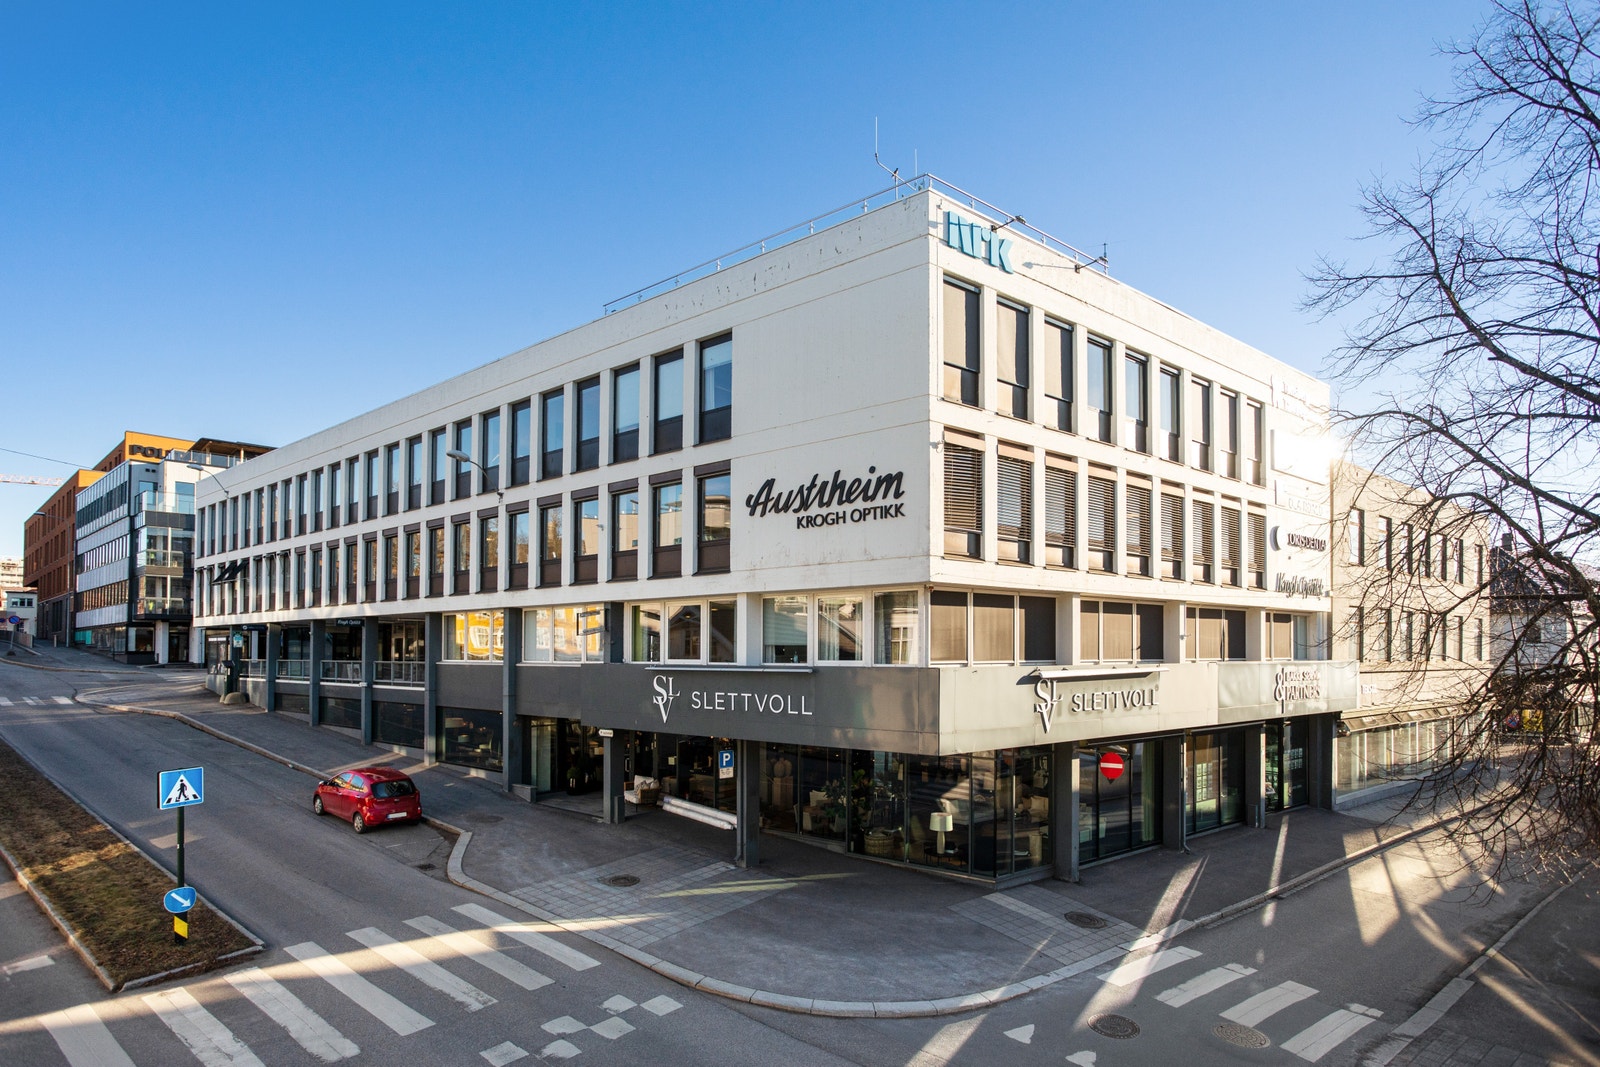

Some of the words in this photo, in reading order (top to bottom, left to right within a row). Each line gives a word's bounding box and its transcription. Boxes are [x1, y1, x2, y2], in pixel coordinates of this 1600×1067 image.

[745, 465, 905, 518] Austrheim
[796, 510, 847, 530] KROGH
[850, 503, 906, 525] OPTIKK
[691, 691, 813, 715] SLETTVOLL
[1071, 687, 1160, 713] SLETTVOLL
[722, 752, 731, 767] P
